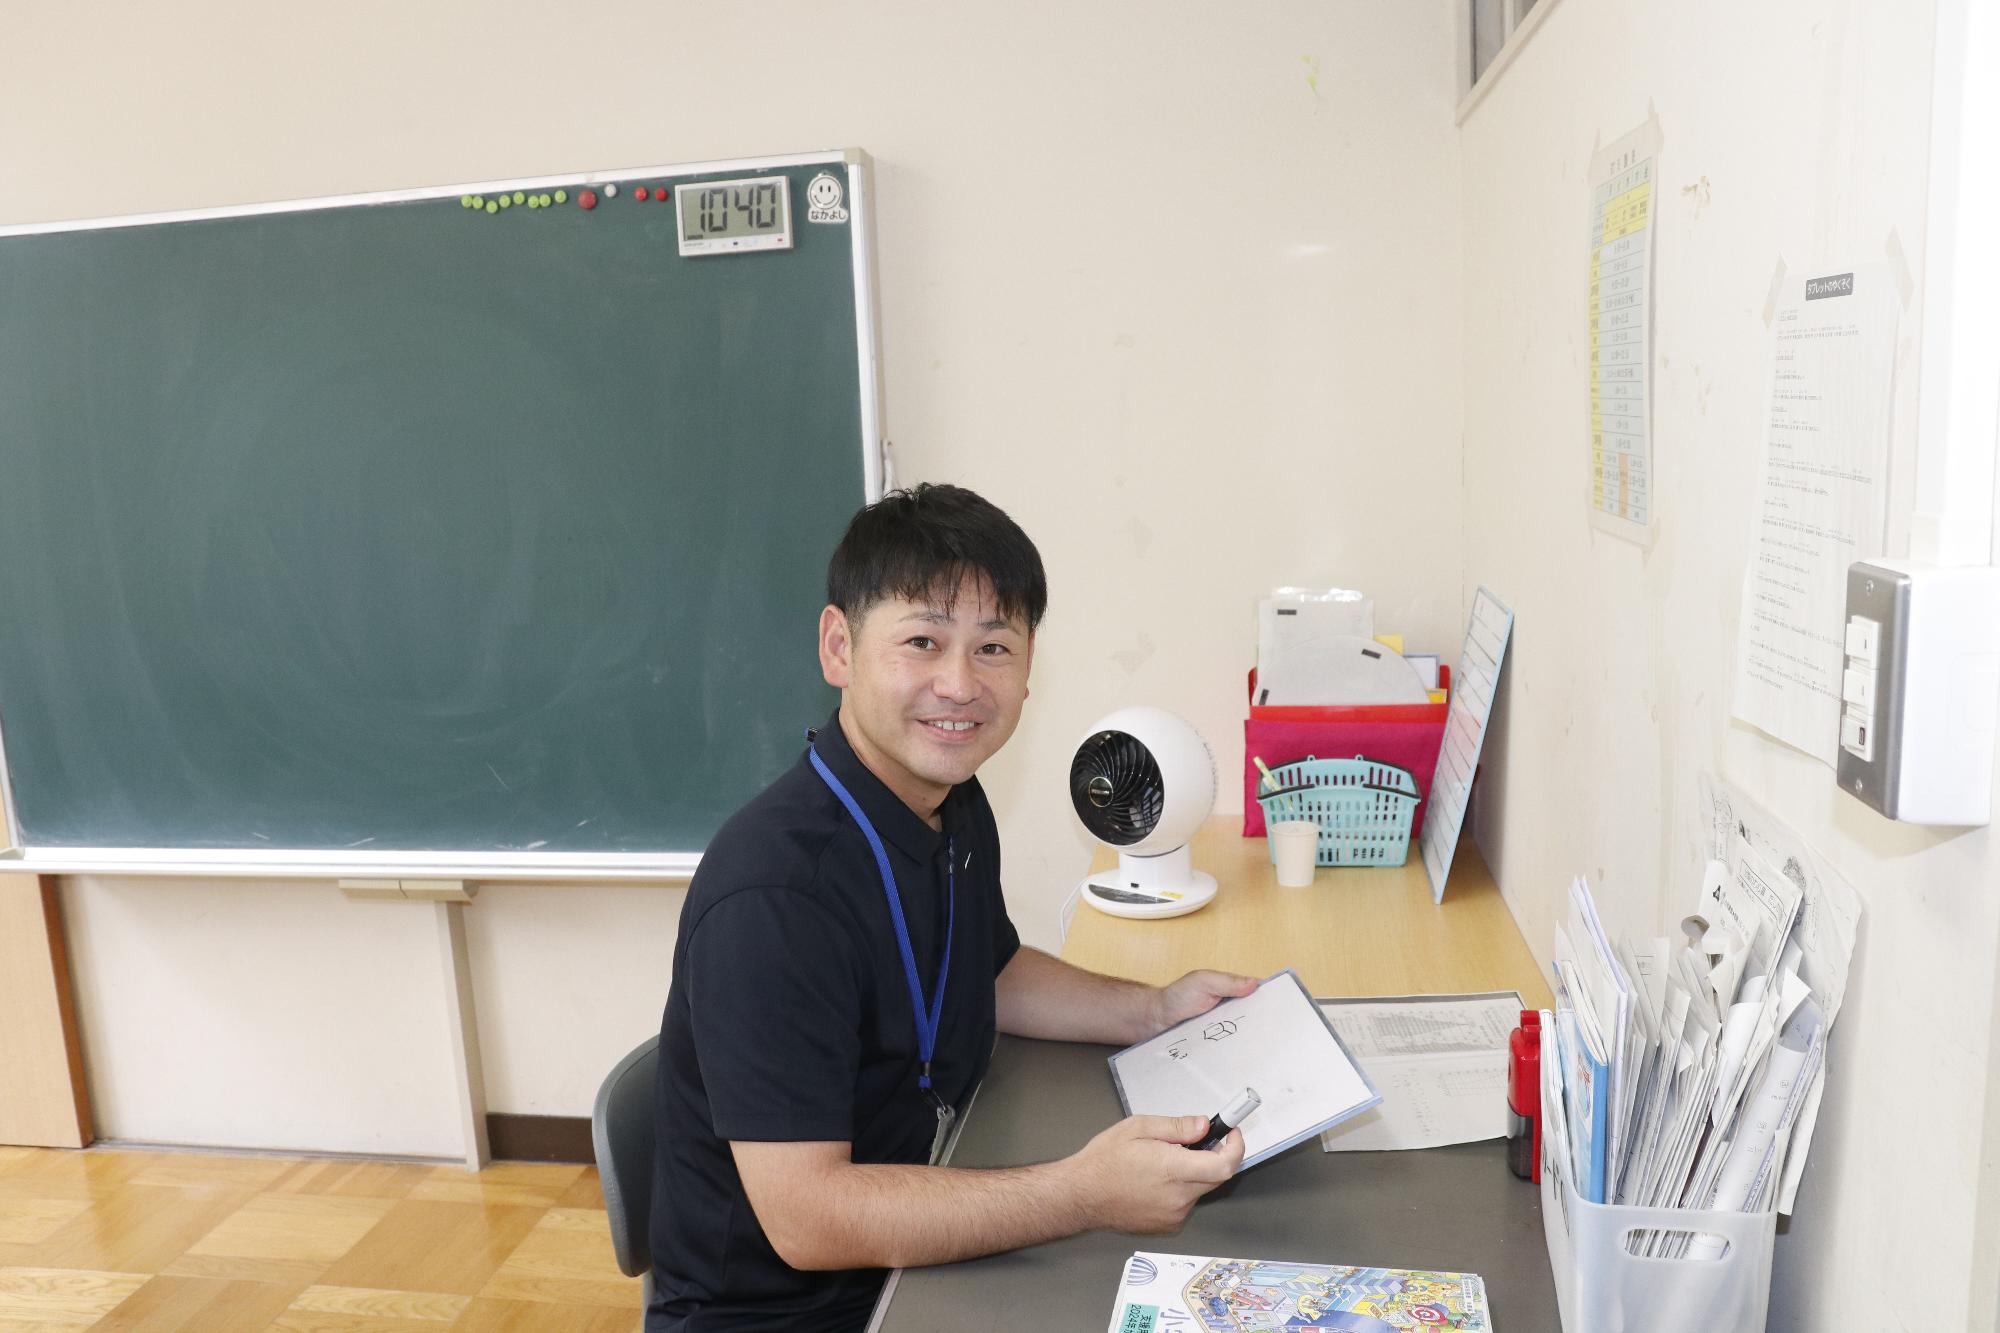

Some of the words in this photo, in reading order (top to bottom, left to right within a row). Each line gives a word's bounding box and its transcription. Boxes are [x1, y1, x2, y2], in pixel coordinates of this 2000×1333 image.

[811, 210, 847, 220] なかよし
[1807, 277, 1851, 296] タブレットのやくそく
